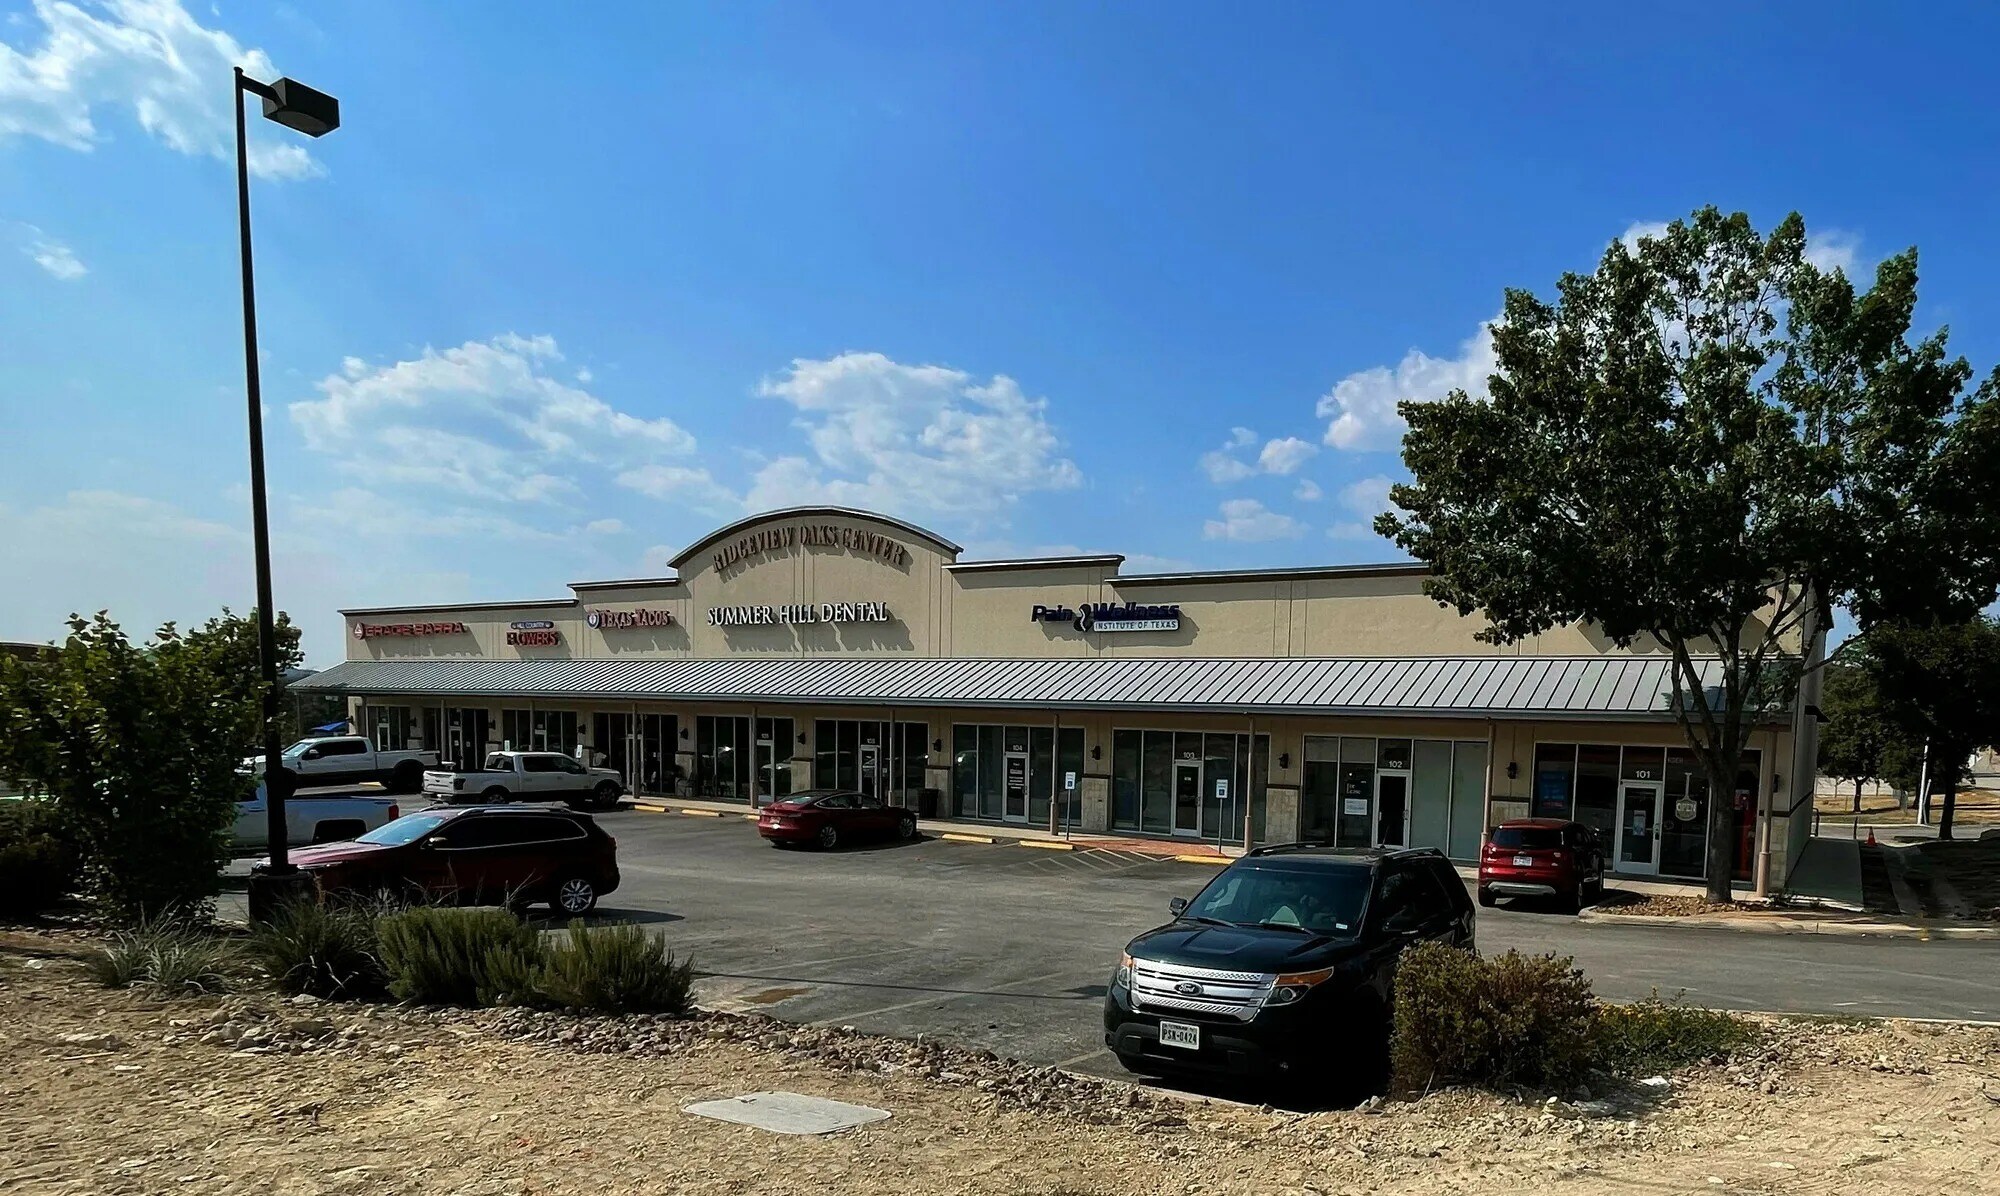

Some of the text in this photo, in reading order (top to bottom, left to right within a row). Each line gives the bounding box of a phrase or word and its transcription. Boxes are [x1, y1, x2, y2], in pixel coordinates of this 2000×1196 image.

[712, 524, 906, 574] RIDGEVIEW OAKS CENTER
[596, 608, 670, 629] TEXAS TACOS
[707, 601, 888, 627] SUMMER HILL DENTAL
[1031, 605, 1075, 622] Pain
[1093, 602, 1179, 621] Wellness
[1095, 620, 1177, 631] INSTITUTE OF TEXAS
[507, 631, 557, 646] FLOWERS
[1388, 760, 1403, 768] 102
[1635, 770, 1651, 778] 101
[1676, 802, 1697, 812] OPEN
[1179, 982, 1195, 992] Ford
